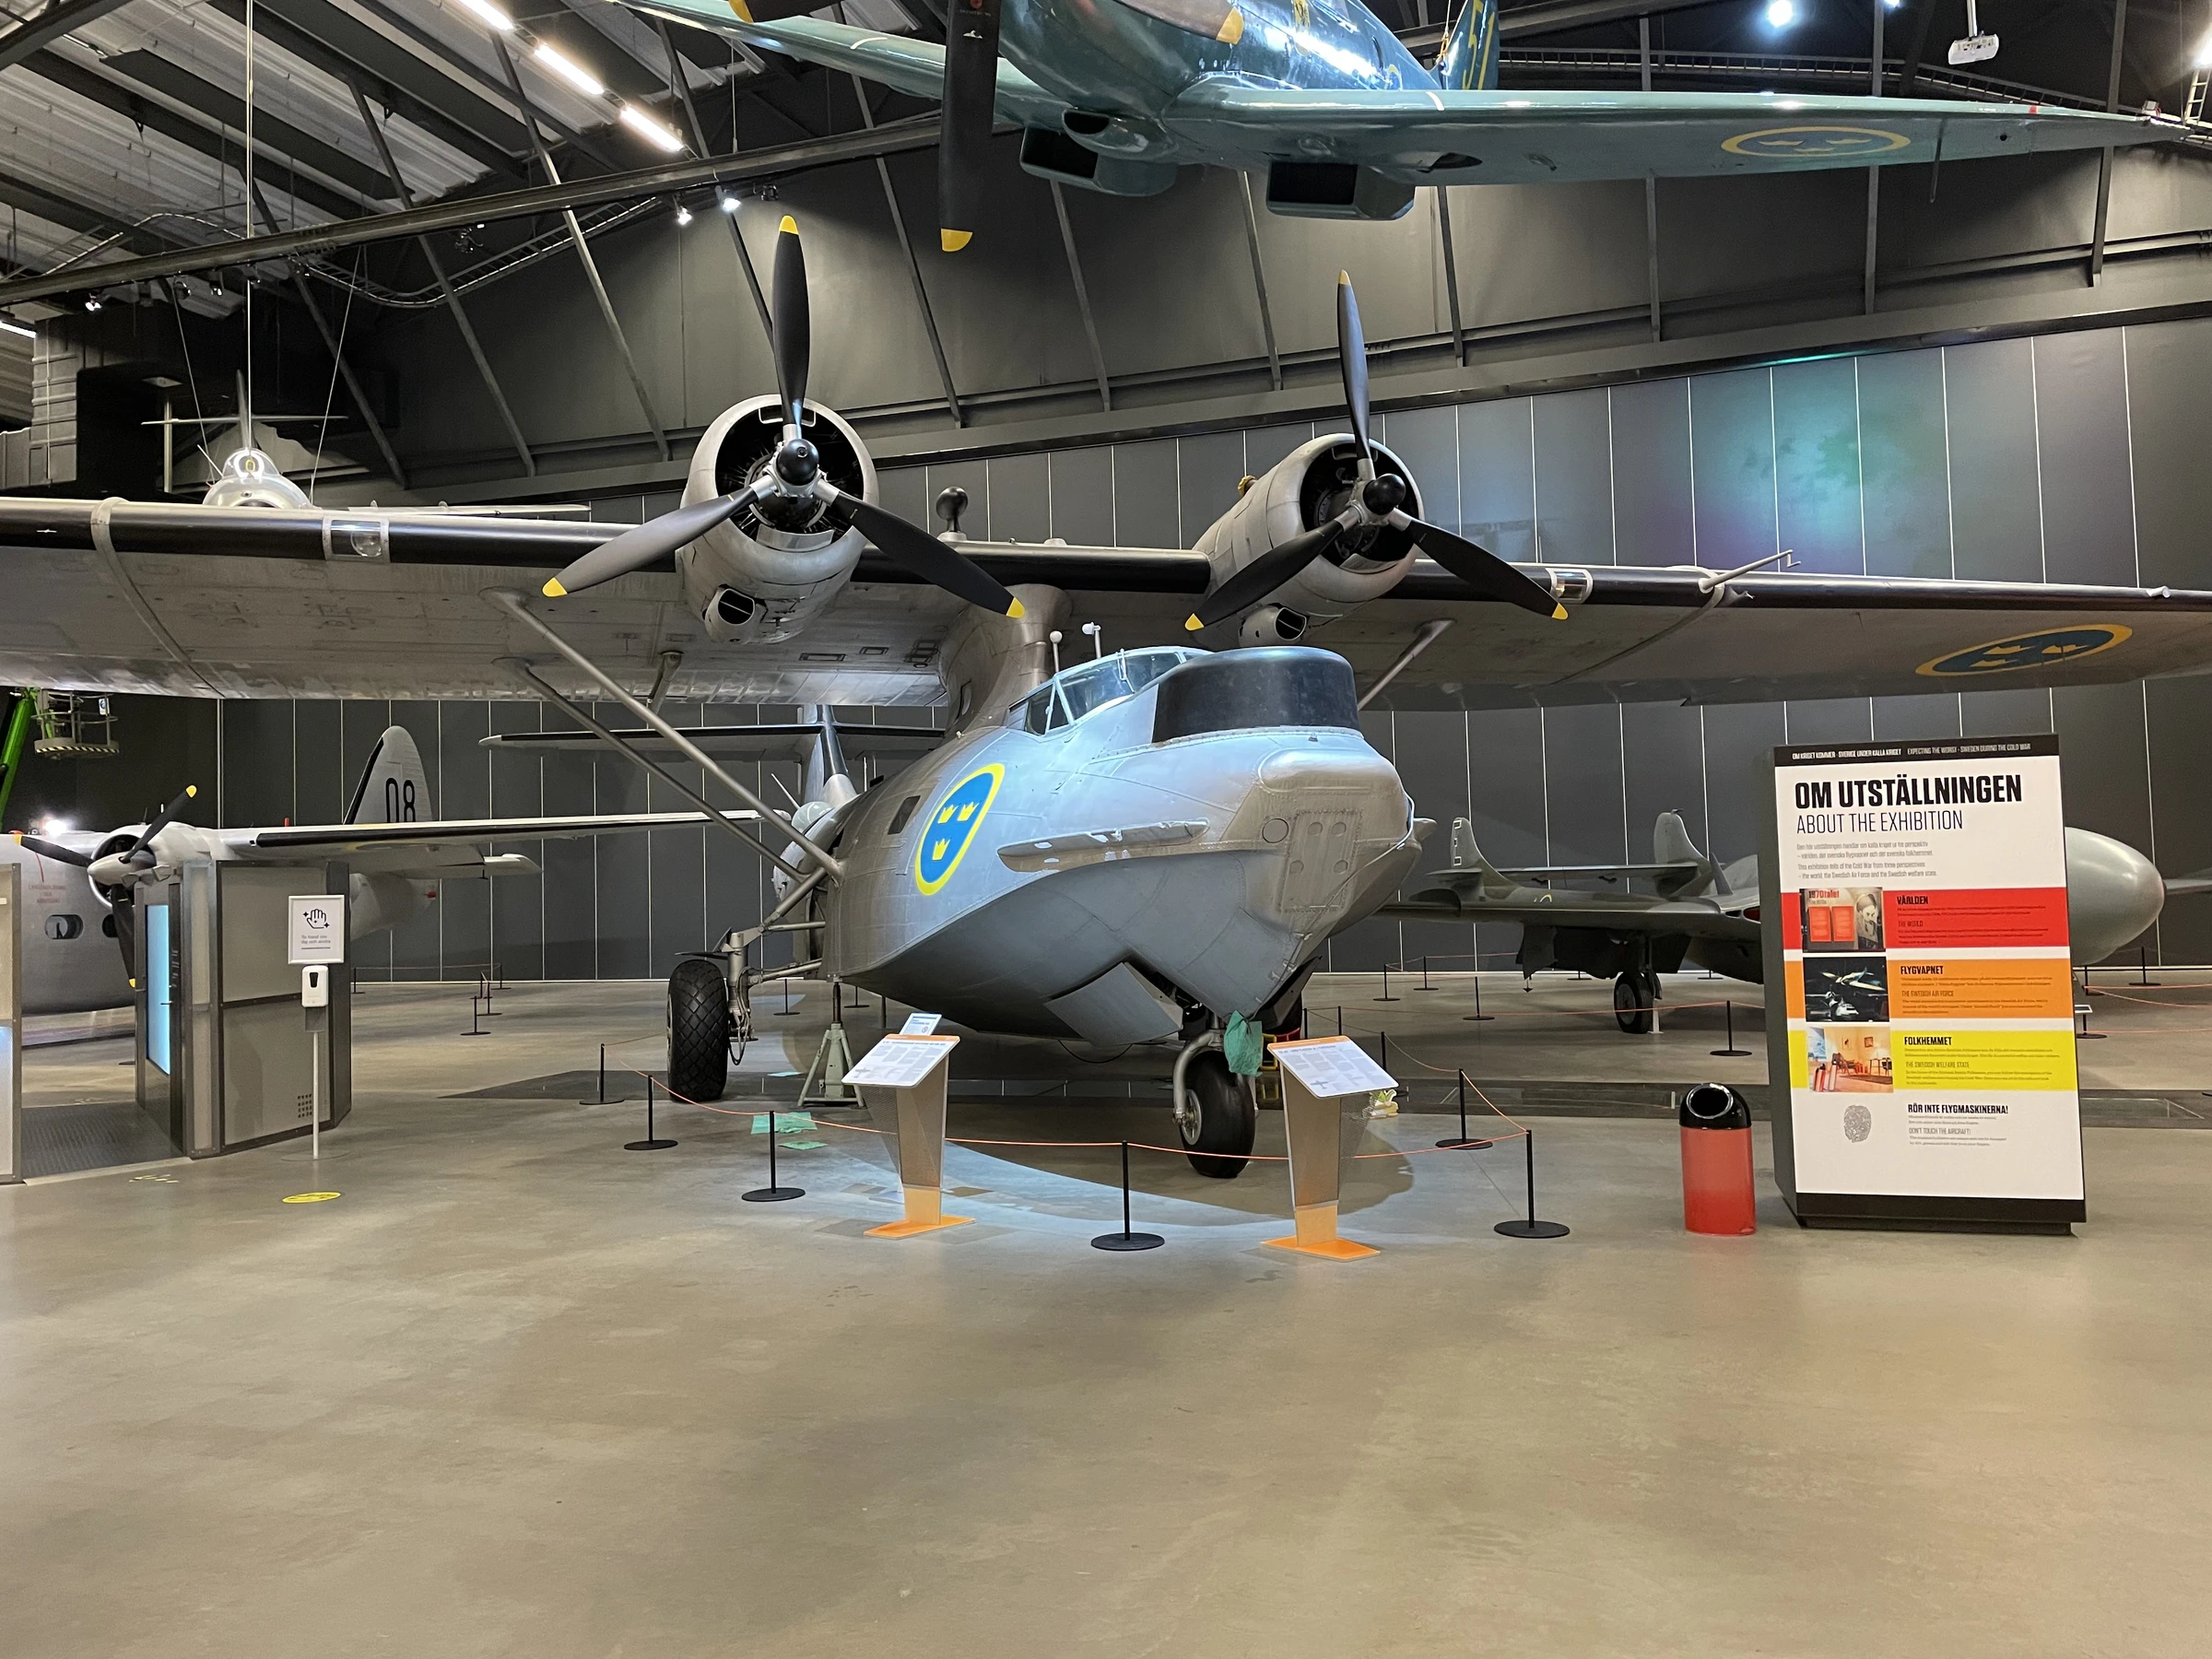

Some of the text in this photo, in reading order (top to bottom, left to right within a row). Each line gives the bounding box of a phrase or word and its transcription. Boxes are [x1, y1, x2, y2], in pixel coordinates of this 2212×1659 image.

[1908, 747, 1932, 756] EXPECTING
[1960, 745, 1980, 753] SWEDEN
[1794, 774, 2022, 809] OM UTSTÄLLNINGEN
[385, 777, 417, 823] 08
[1796, 809, 1964, 834] ABOUT THE EXHIBITION
[1897, 895, 1928, 905] VÄRLDEN
[1900, 965, 1944, 975] FLYGVAPNET
[1904, 1036, 1952, 1045] FOLKHEMMET
[1908, 1102, 2008, 1114] RÖR INTE FLYGMASKINERNA!
